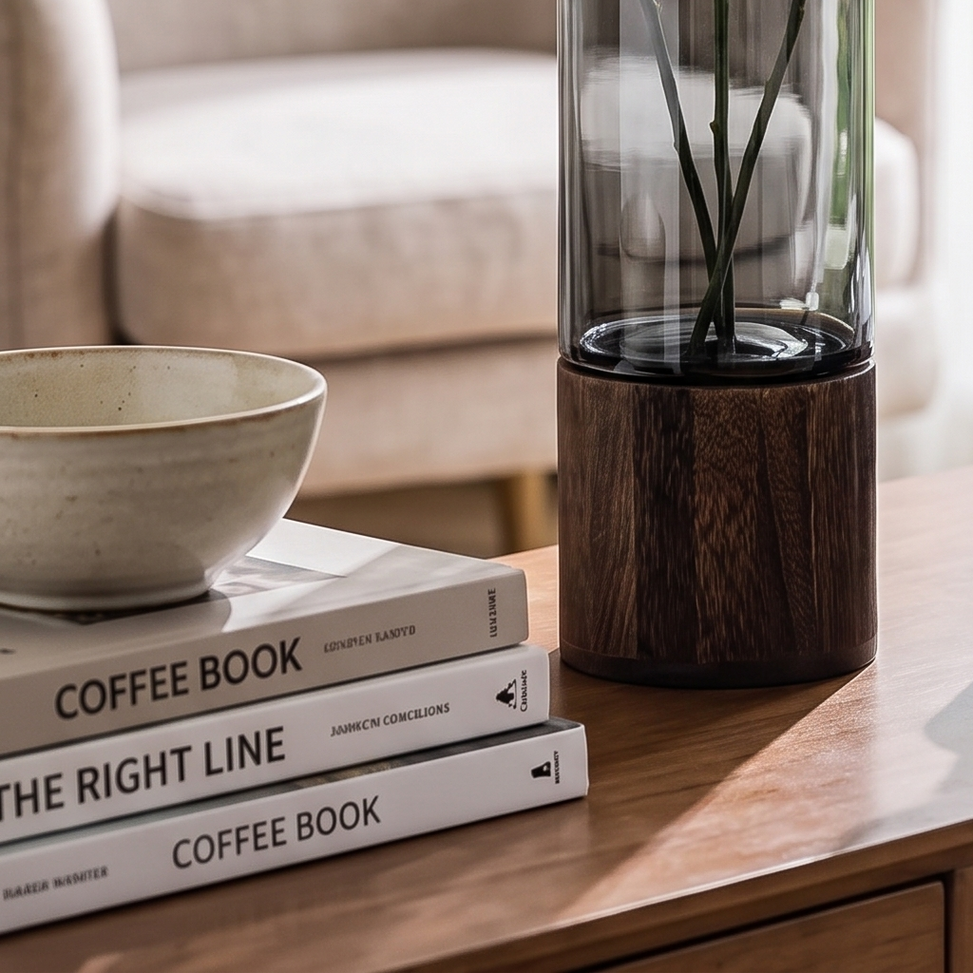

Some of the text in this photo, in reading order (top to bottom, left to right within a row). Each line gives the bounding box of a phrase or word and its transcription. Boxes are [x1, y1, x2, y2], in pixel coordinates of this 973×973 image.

[55, 637, 303, 720] COFFEE BOOK
[0, 726, 286, 822] THE RIGHT LINE
[172, 794, 381, 869] COFFEE BOOK
